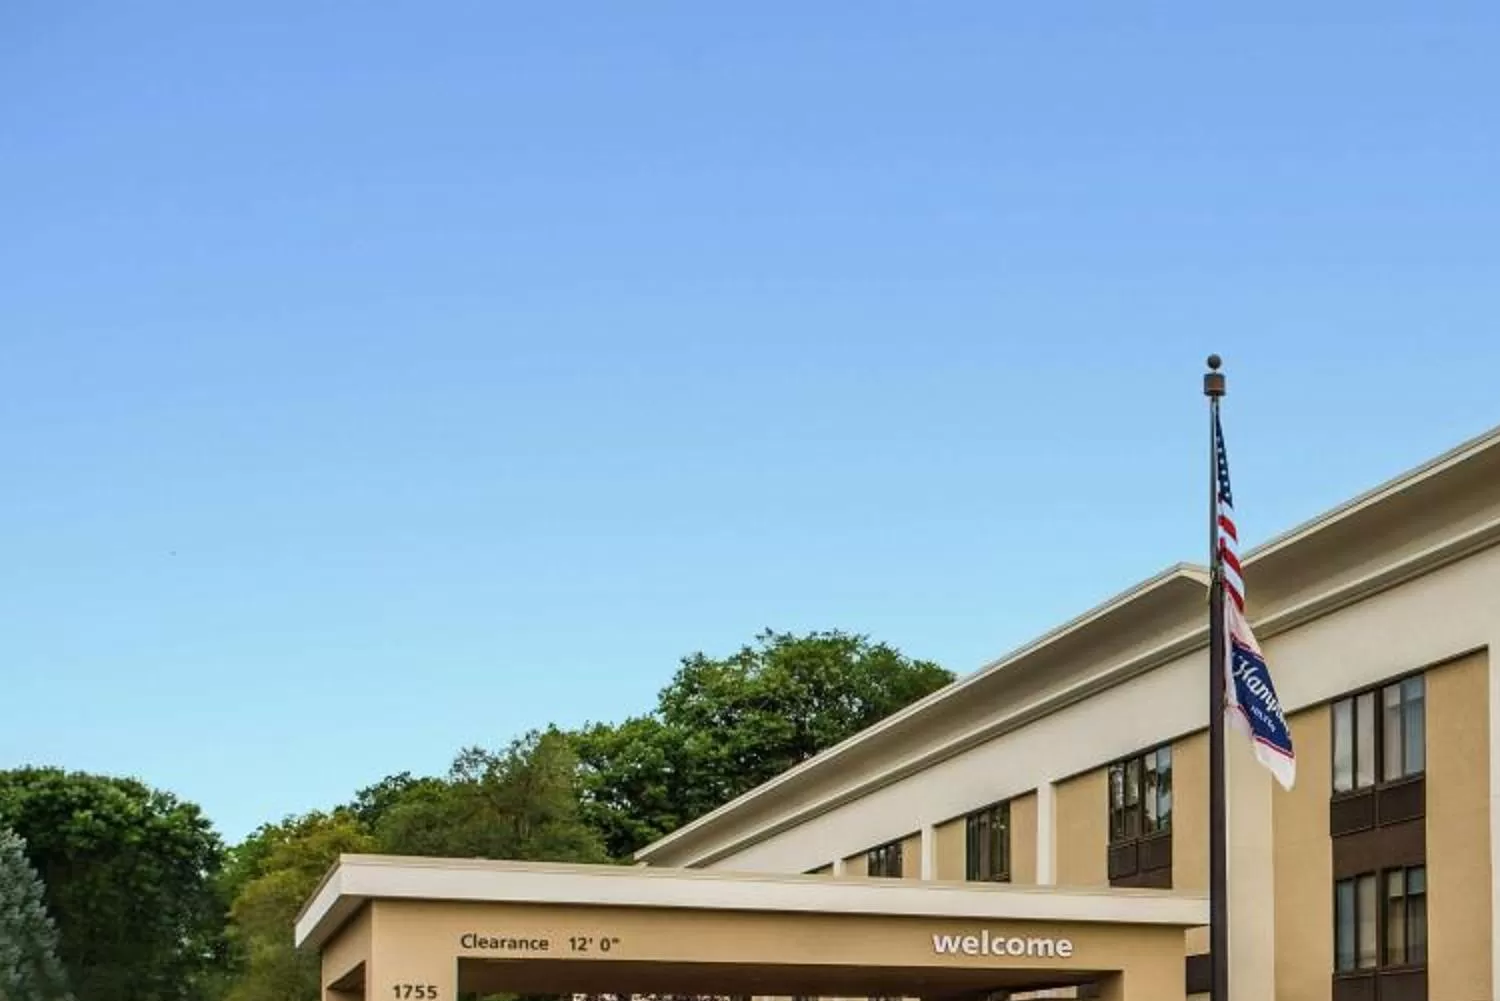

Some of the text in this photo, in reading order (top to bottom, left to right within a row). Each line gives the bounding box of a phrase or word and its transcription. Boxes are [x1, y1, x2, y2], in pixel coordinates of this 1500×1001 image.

[1232, 653, 1290, 733] Hamp
[460, 933, 549, 951] Clearance
[568, 937, 593, 952] 12'
[932, 929, 1073, 958] welcome
[392, 984, 438, 1000] 1755
